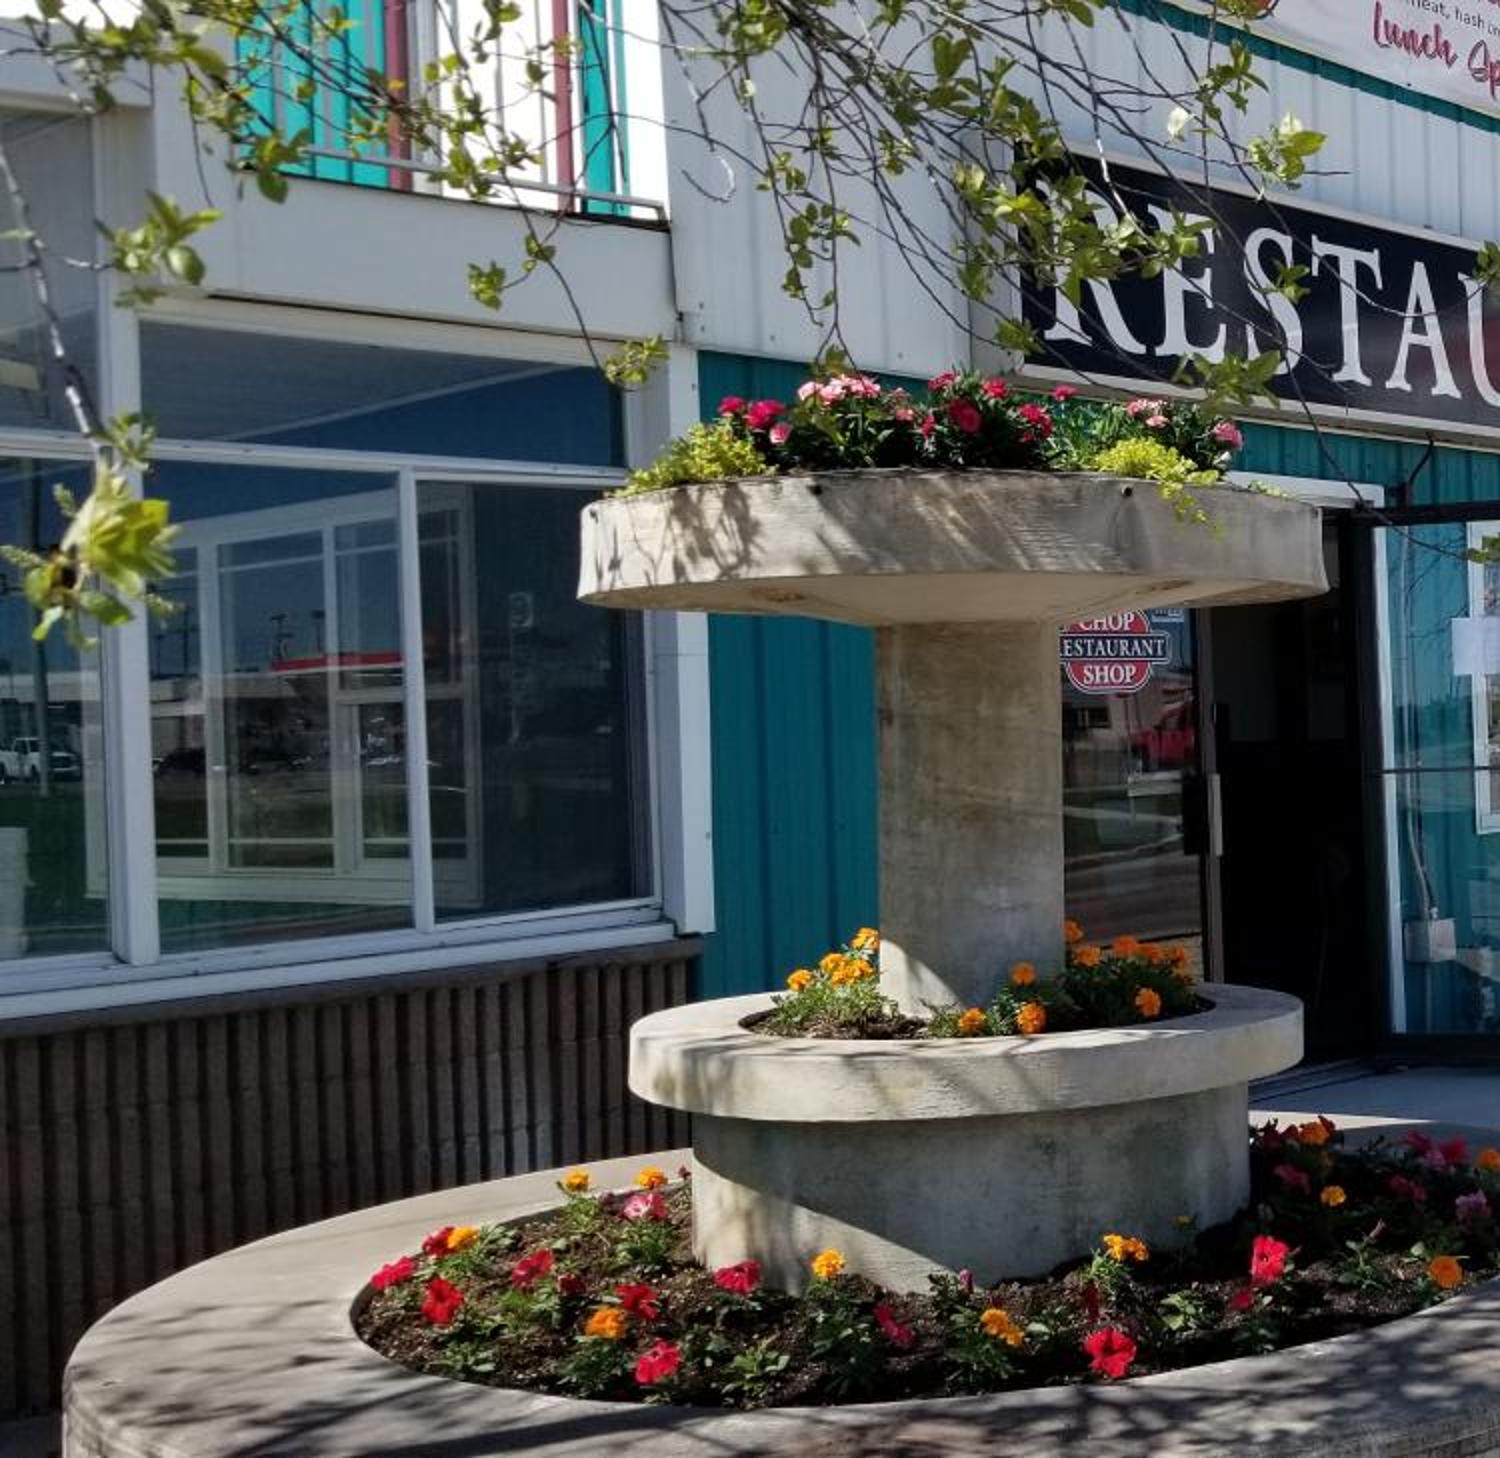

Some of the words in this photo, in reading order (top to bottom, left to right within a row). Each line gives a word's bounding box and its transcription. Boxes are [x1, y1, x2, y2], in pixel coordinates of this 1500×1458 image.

[1455, 6, 1484, 28] hash
[1373, 1, 1457, 68] Lunch
[1060, 638, 1165, 657] ESTAURANT
[1083, 664, 1137, 684] SHOP
